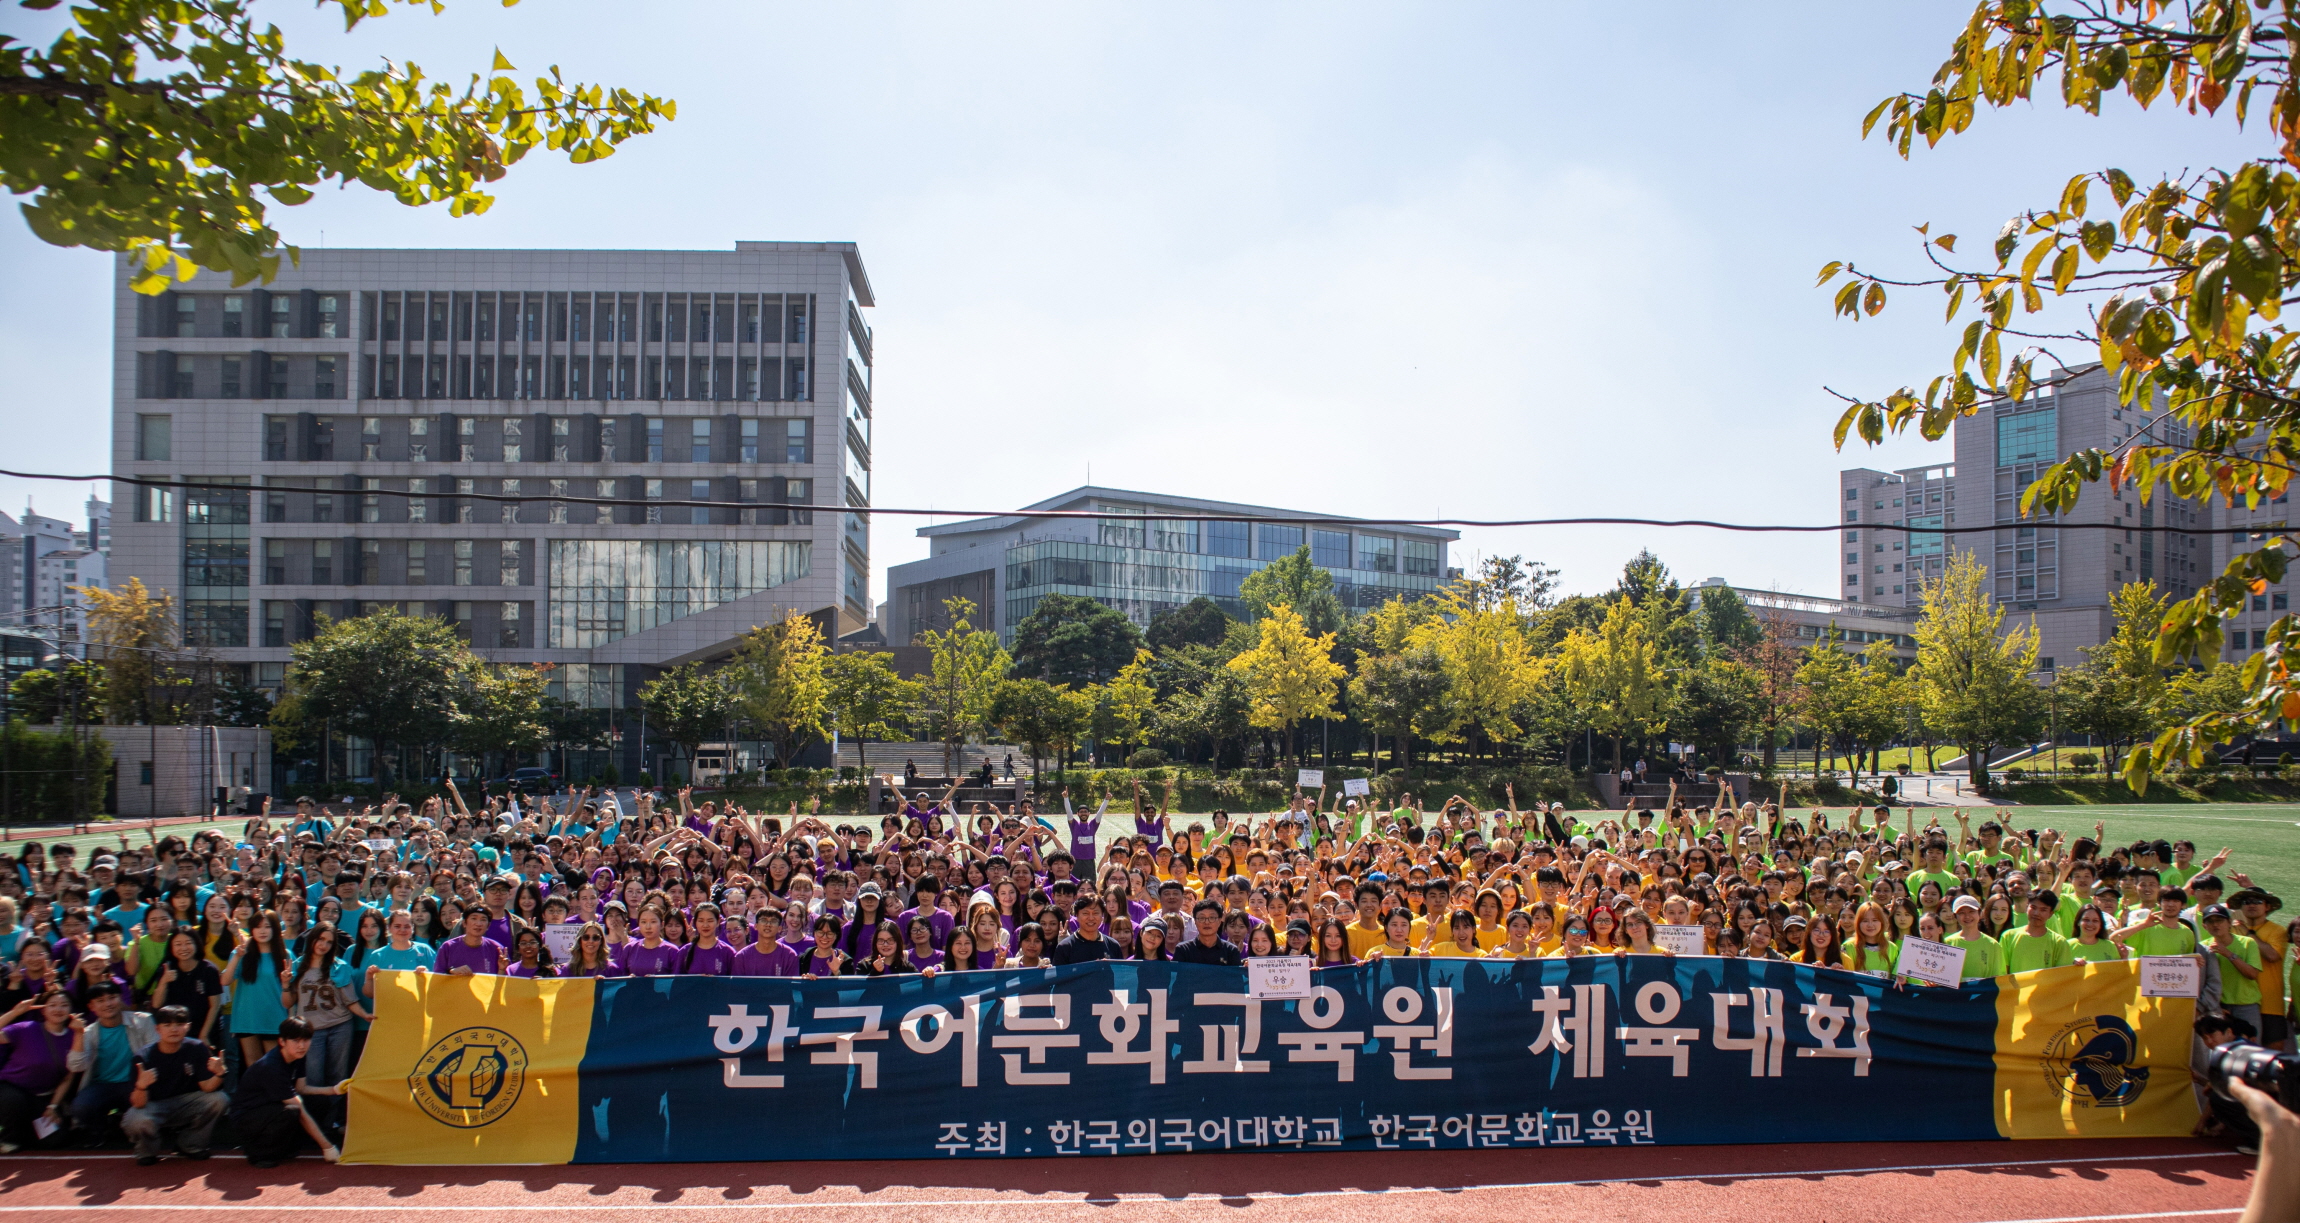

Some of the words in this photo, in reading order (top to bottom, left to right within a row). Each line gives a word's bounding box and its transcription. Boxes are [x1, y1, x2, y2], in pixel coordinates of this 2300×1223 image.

[1668, 943, 1681, 951] 우승
[1923, 958, 1938, 968] 우승
[1273, 975, 1287, 984] 우승
[2156, 972, 2184, 981] 종합우승
[301, 984, 336, 1012] 79
[2064, 1016, 2093, 1030] STUDIES
[708, 985, 1453, 1089] 한국어문화교육원
[1528, 981, 1873, 1078] 체육대회
[426, 1031, 523, 1067] 한국외국어대학교
[424, 1096, 466, 1122] UNIVERSITY
[480, 1096, 511, 1120] FOREIGN
[935, 1121, 1008, 1156] 주최
[1047, 1114, 1344, 1156] 한국외국어대학교
[1368, 1108, 1656, 1149] 한국어문화교육원
